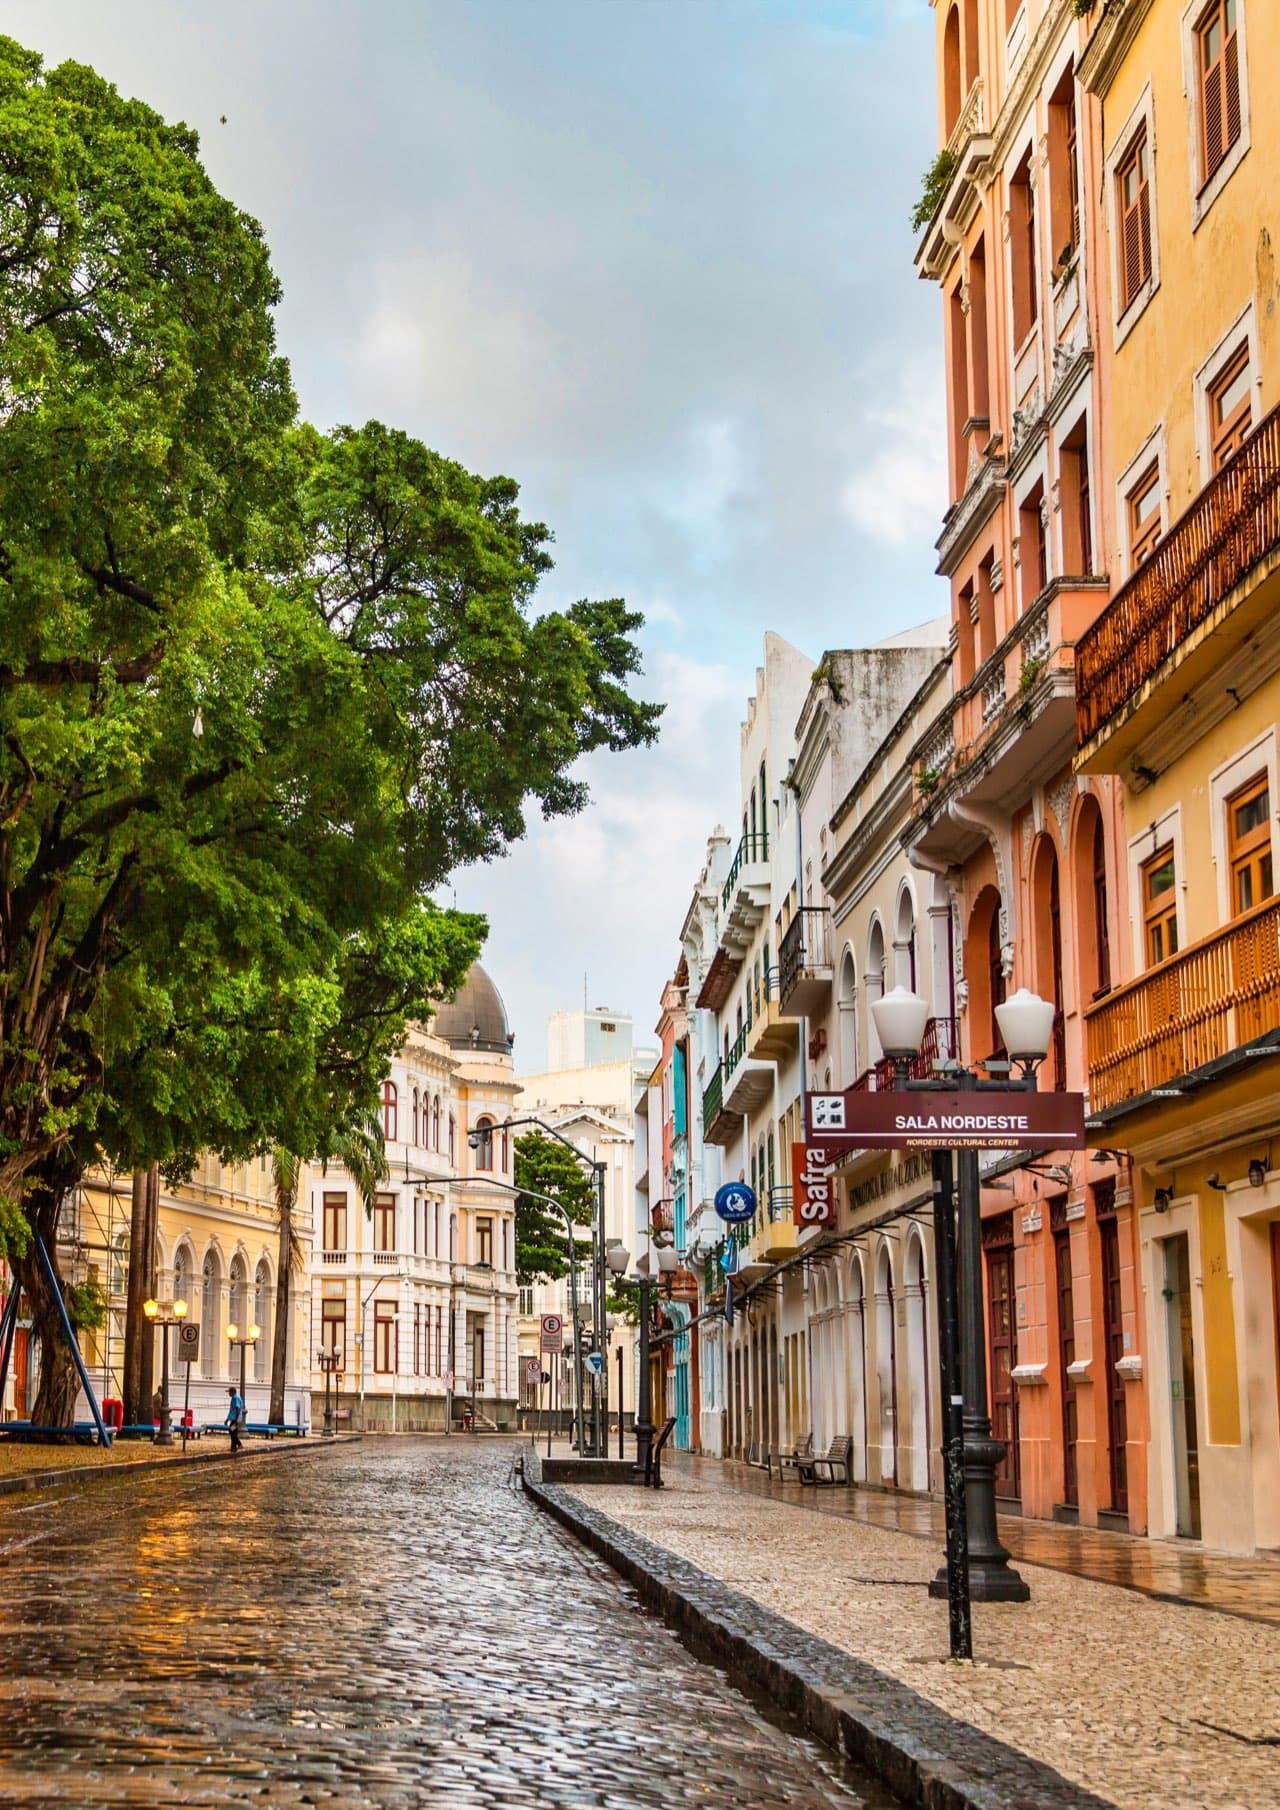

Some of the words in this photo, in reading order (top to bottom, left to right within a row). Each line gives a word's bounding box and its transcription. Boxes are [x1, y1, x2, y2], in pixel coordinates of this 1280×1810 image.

[895, 1115, 938, 1129] SALA
[941, 1115, 1029, 1129] NORDESTE
[906, 1138, 947, 1147] NORDESTE
[948, 1138, 987, 1147] CULTURAL
[988, 1138, 1019, 1147] CENTER
[800, 1148, 829, 1220] Safra
[548, 1320, 555, 1330] E
